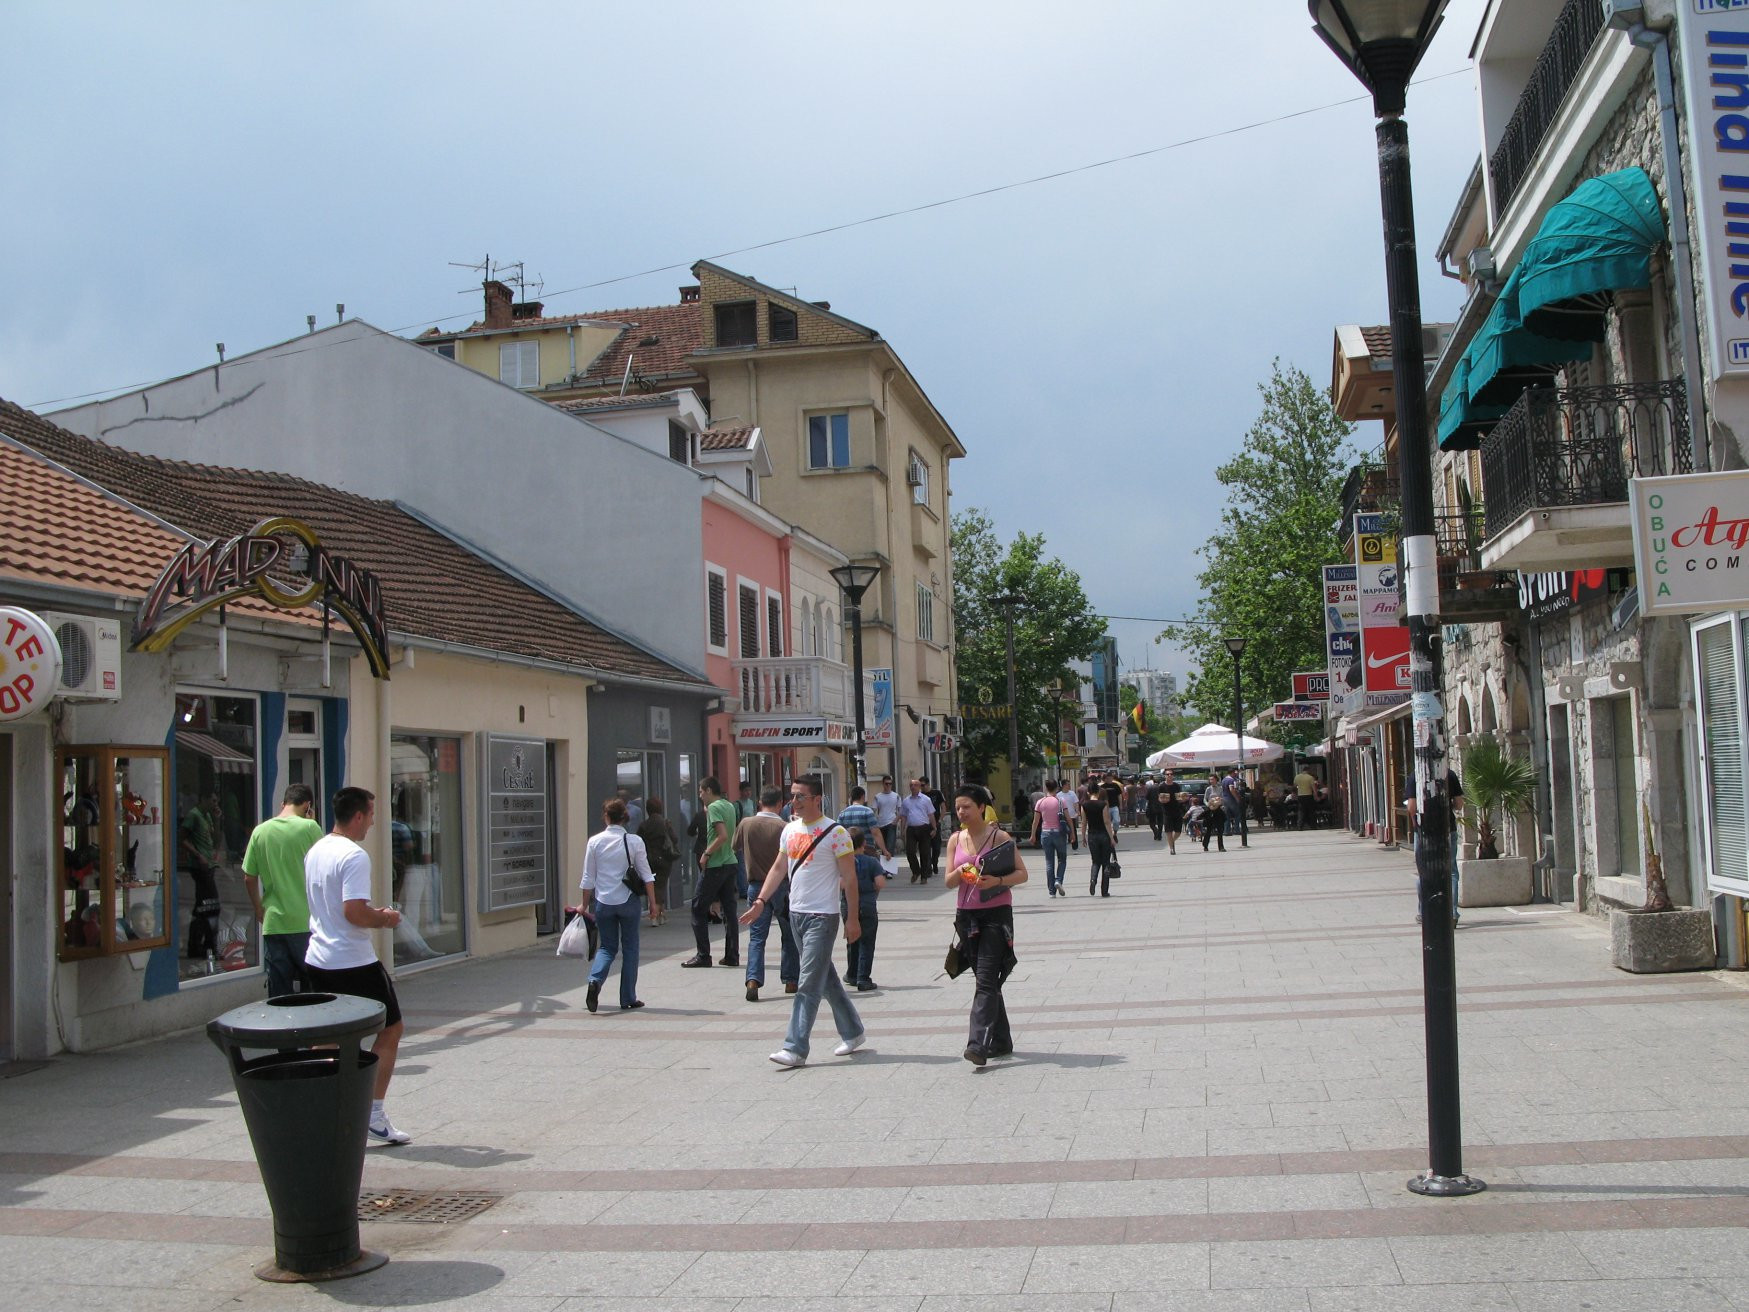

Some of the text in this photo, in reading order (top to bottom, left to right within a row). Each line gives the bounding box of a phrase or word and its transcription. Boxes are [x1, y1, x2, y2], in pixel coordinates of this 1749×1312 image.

[1685, 555, 1740, 572] COM
[740, 728, 781, 738] DELFIN
[783, 727, 823, 737] SPORT
[928, 734, 953, 752] TRES
